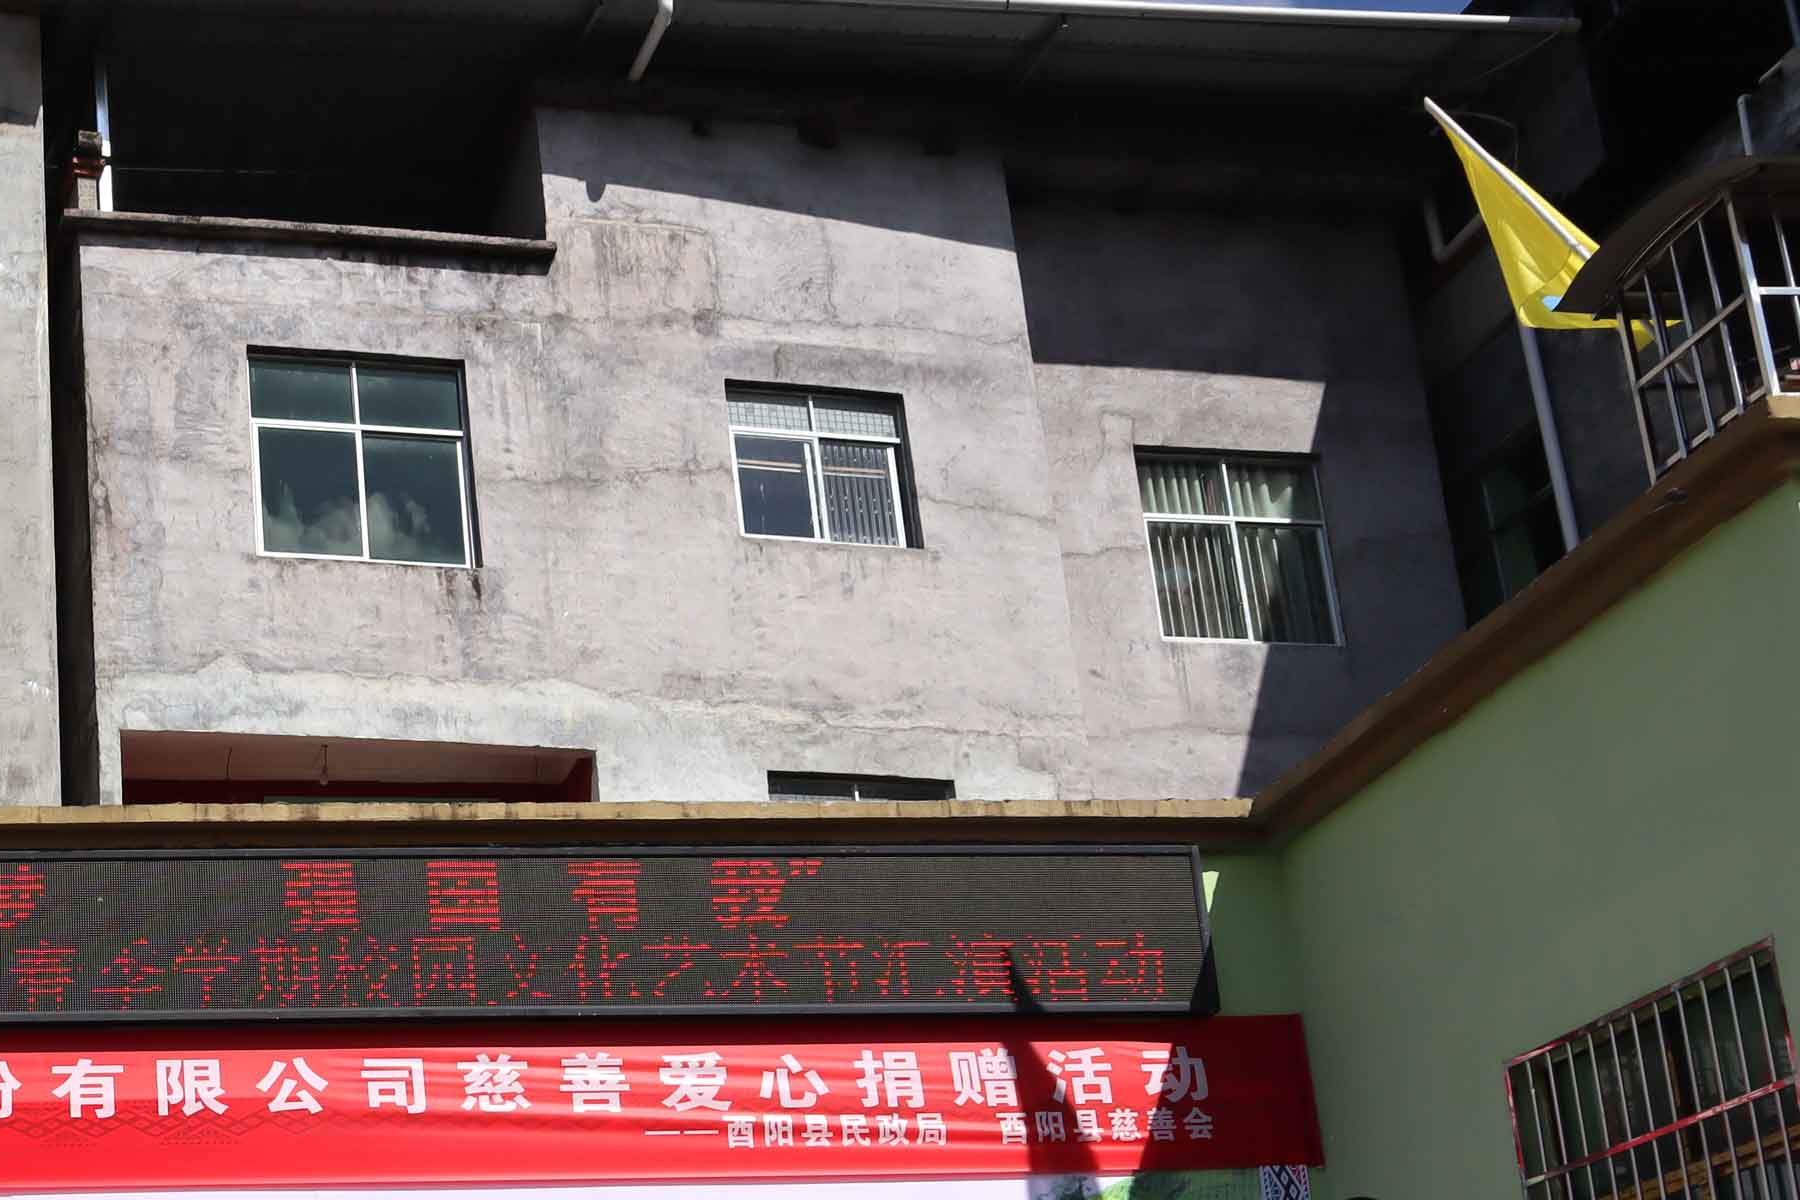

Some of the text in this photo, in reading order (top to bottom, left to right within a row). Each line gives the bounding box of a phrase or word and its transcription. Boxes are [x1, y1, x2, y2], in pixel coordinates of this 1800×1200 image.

[1000, 1107, 1213, 1144] 酉阳县慈善会
